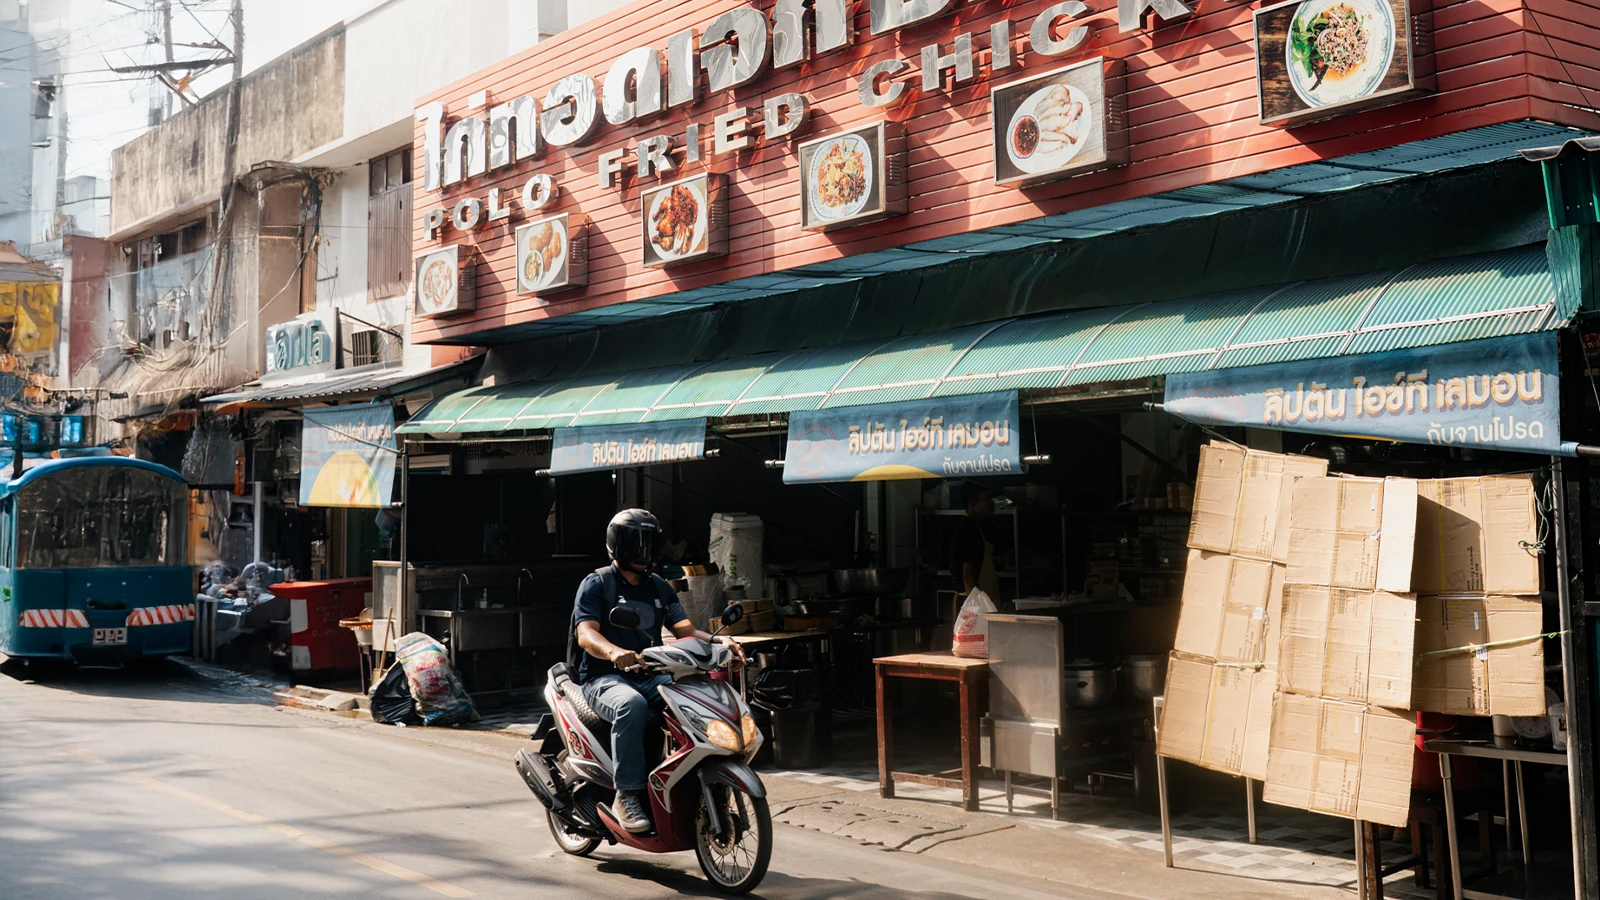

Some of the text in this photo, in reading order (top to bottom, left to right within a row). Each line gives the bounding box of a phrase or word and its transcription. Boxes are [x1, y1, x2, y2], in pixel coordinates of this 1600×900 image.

[423, 173, 552, 242] POLO
[598, 93, 805, 189] FRIED
[1263, 381, 1346, 423] ลิปตัน
[1436, 368, 1541, 410] เลมอน
[848, 421, 895, 453] ลิปตัน
[947, 419, 1009, 446] เลมอน
[1426, 415, 1544, 445] กับจานโปรด
